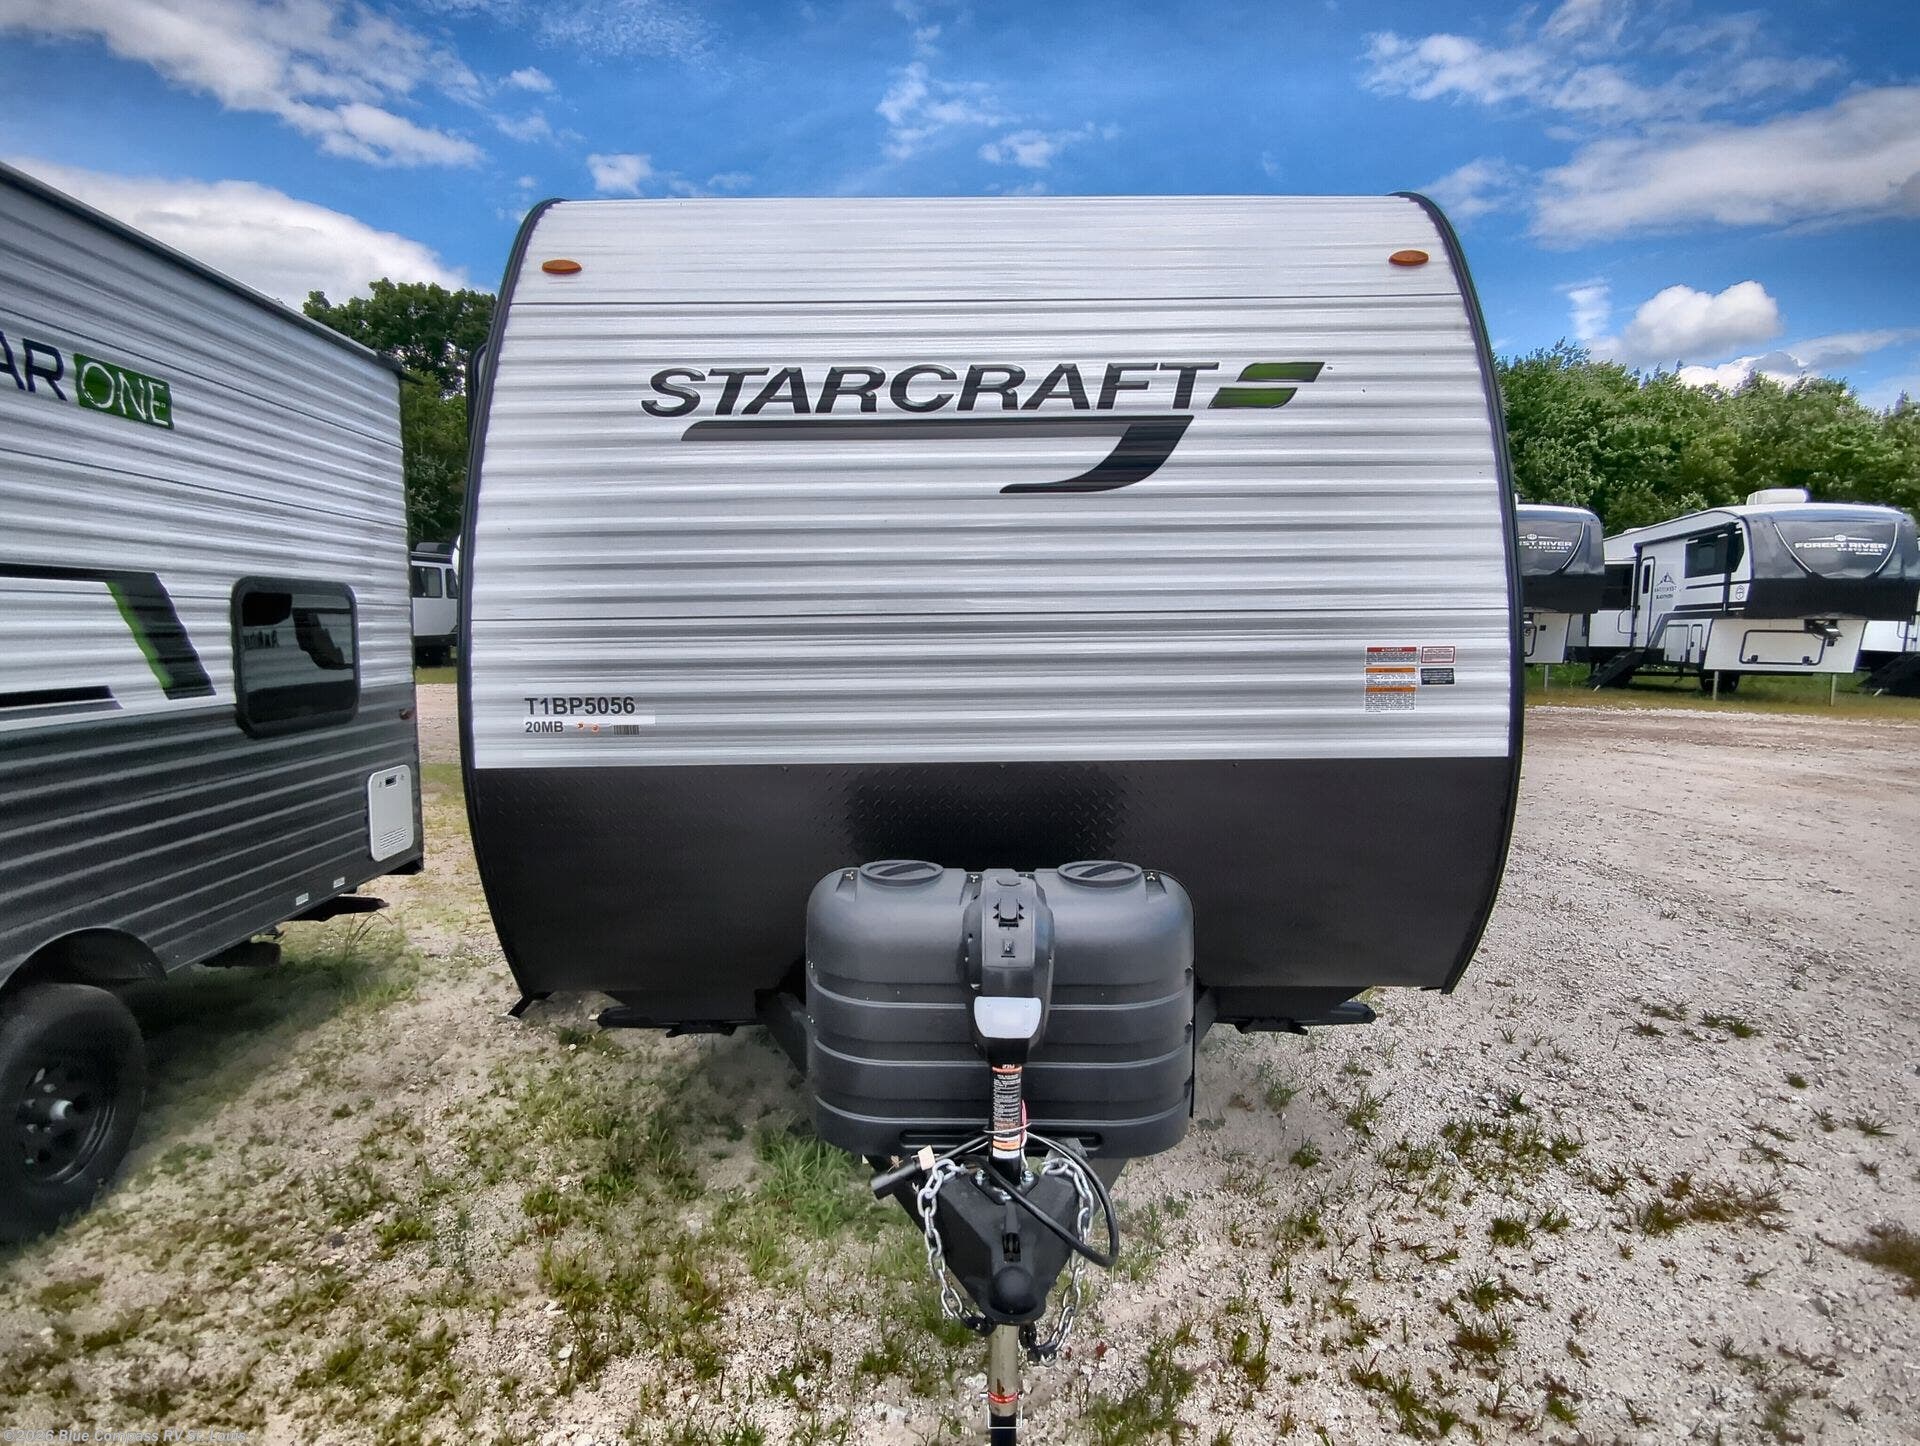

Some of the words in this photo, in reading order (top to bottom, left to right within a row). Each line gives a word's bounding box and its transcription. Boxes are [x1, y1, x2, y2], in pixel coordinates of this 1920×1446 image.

[81, 362, 169, 426] ONE
[641, 361, 1219, 417] STARCRAFT
[525, 696, 635, 715] T1BP5056
[525, 721, 563, 733] 20MB
